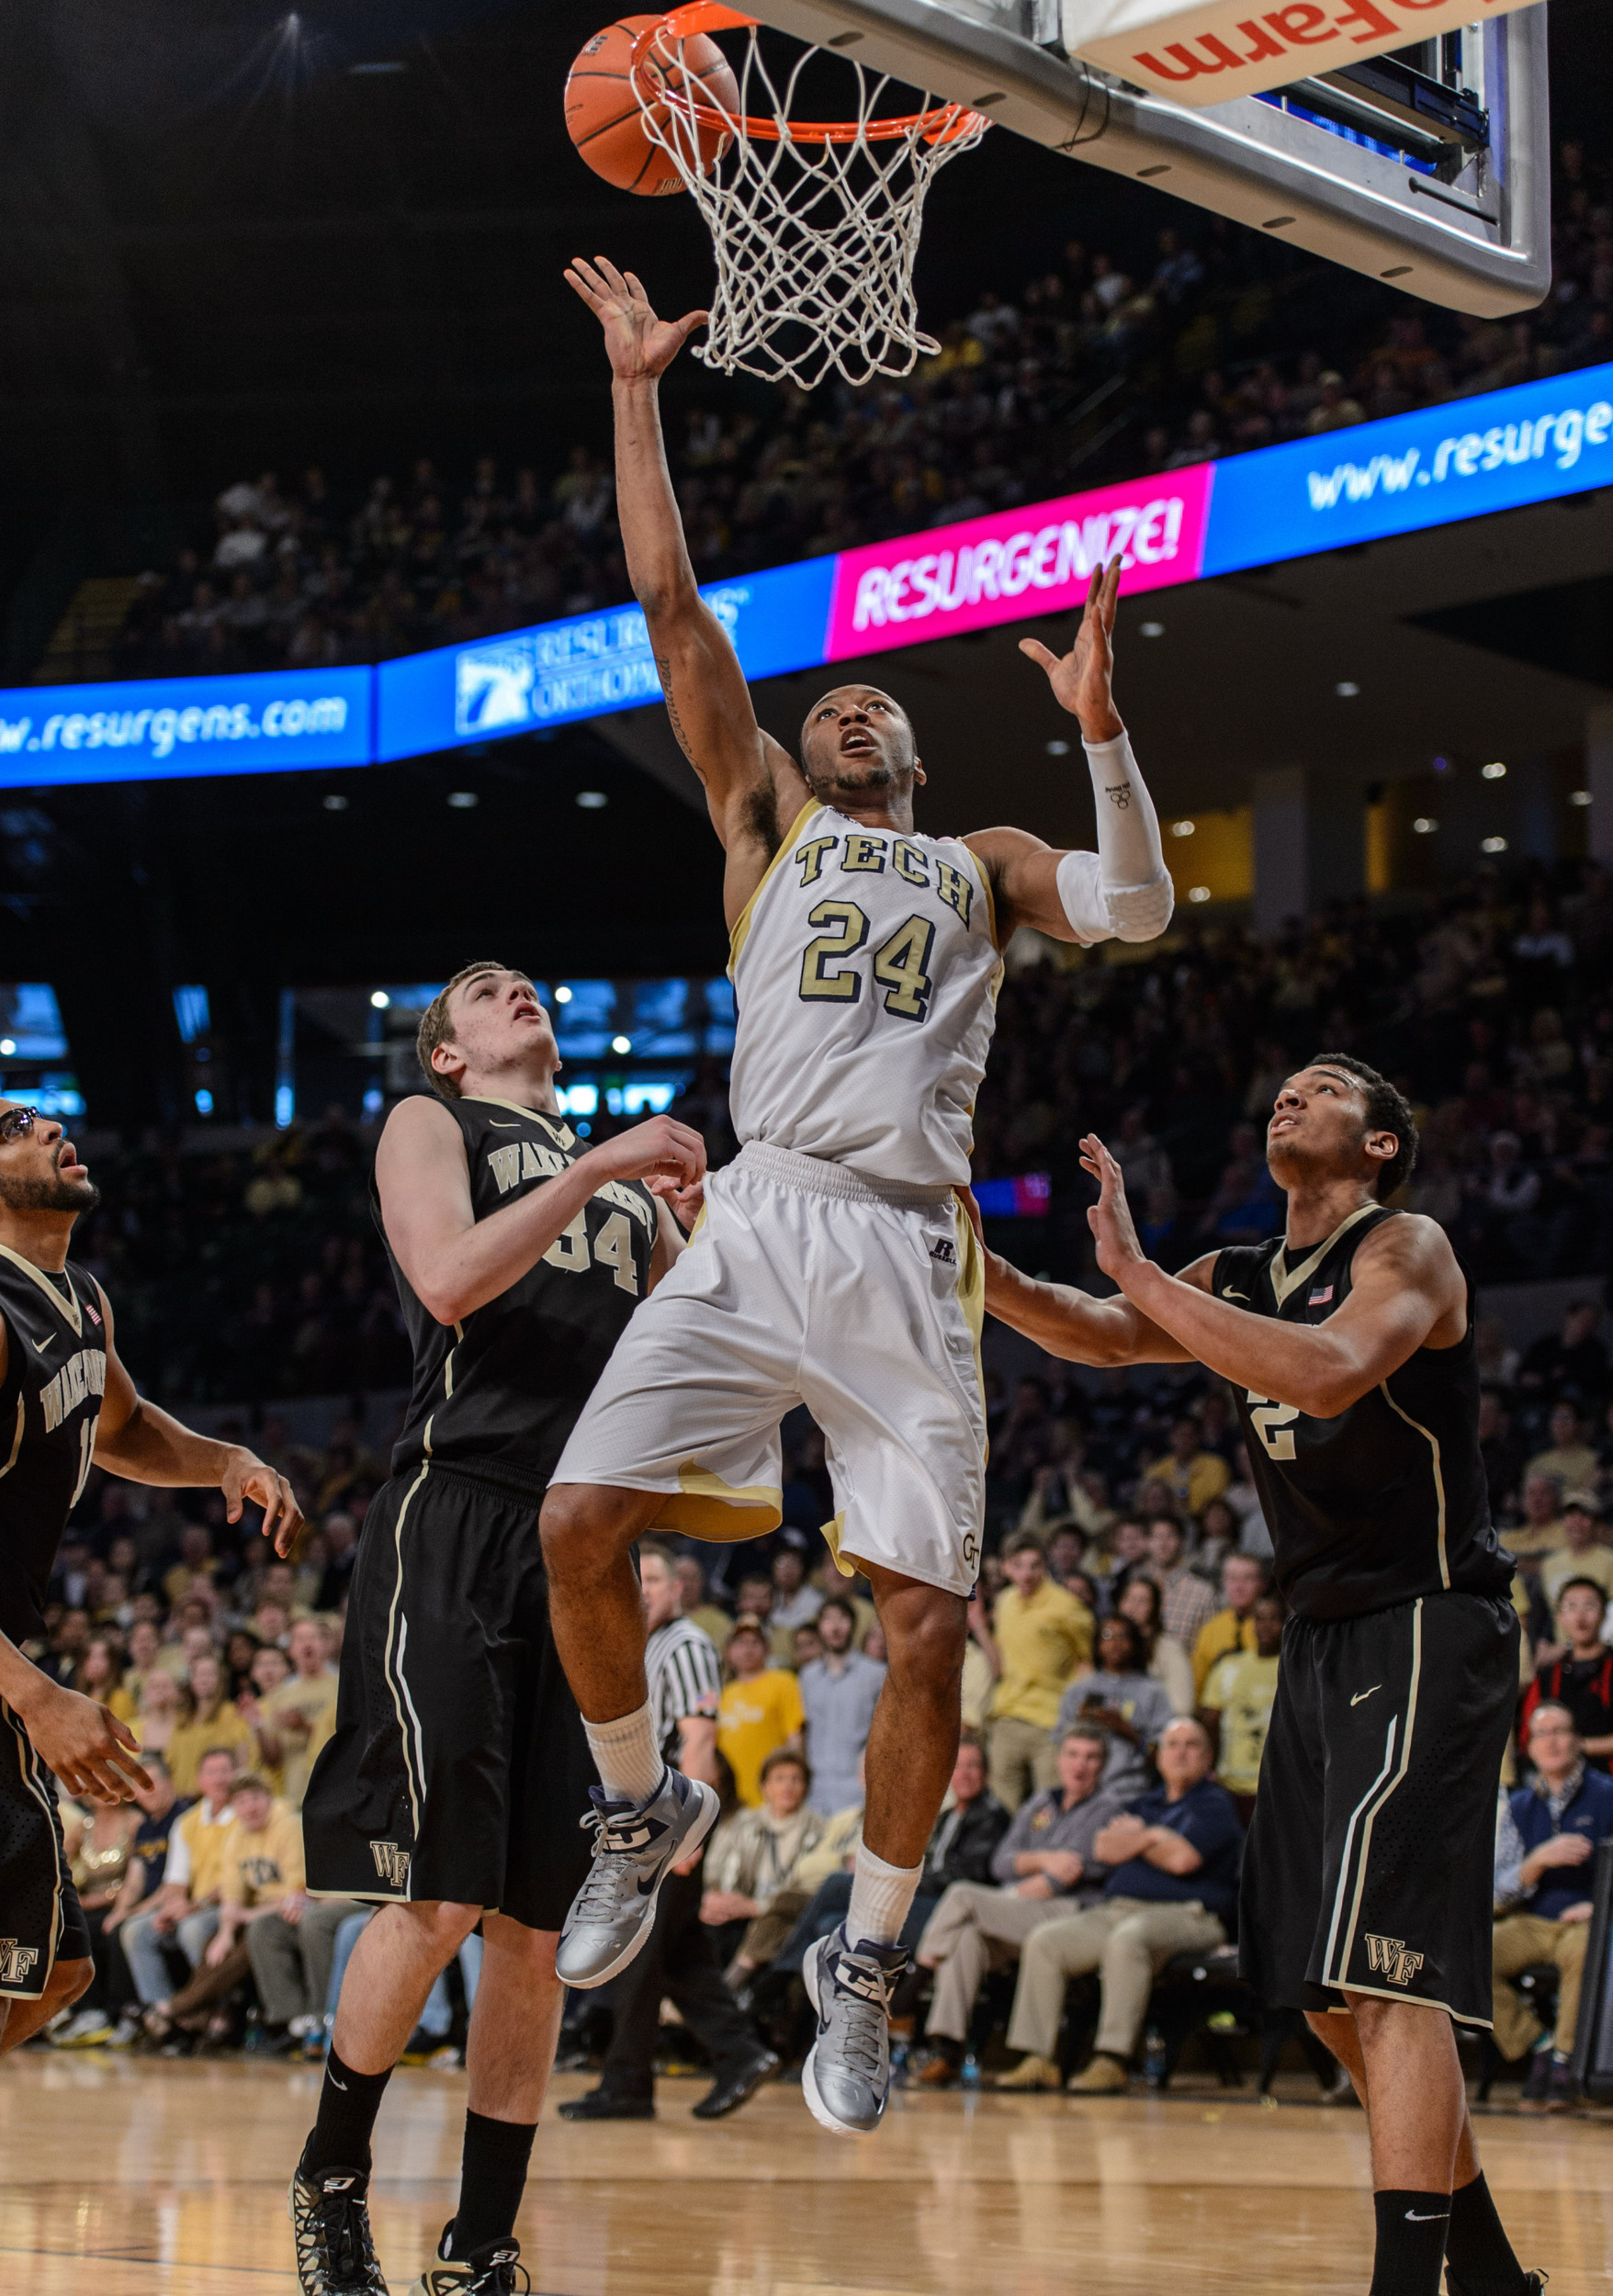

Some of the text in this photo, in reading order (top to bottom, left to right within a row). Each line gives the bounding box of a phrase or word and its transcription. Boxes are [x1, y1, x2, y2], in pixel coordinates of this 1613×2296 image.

[1133, 0, 1402, 81] Farm
[852, 496, 1185, 632] RESURGENIZE!
[795, 835, 974, 931] TECH
[798, 899, 936, 1023] 24
[929, 1250, 957, 1266] RUSSELL
[963, 1533, 980, 1570] GT
[369, 1840, 411, 1887] WF
[1364, 1932, 1425, 1986] WF
